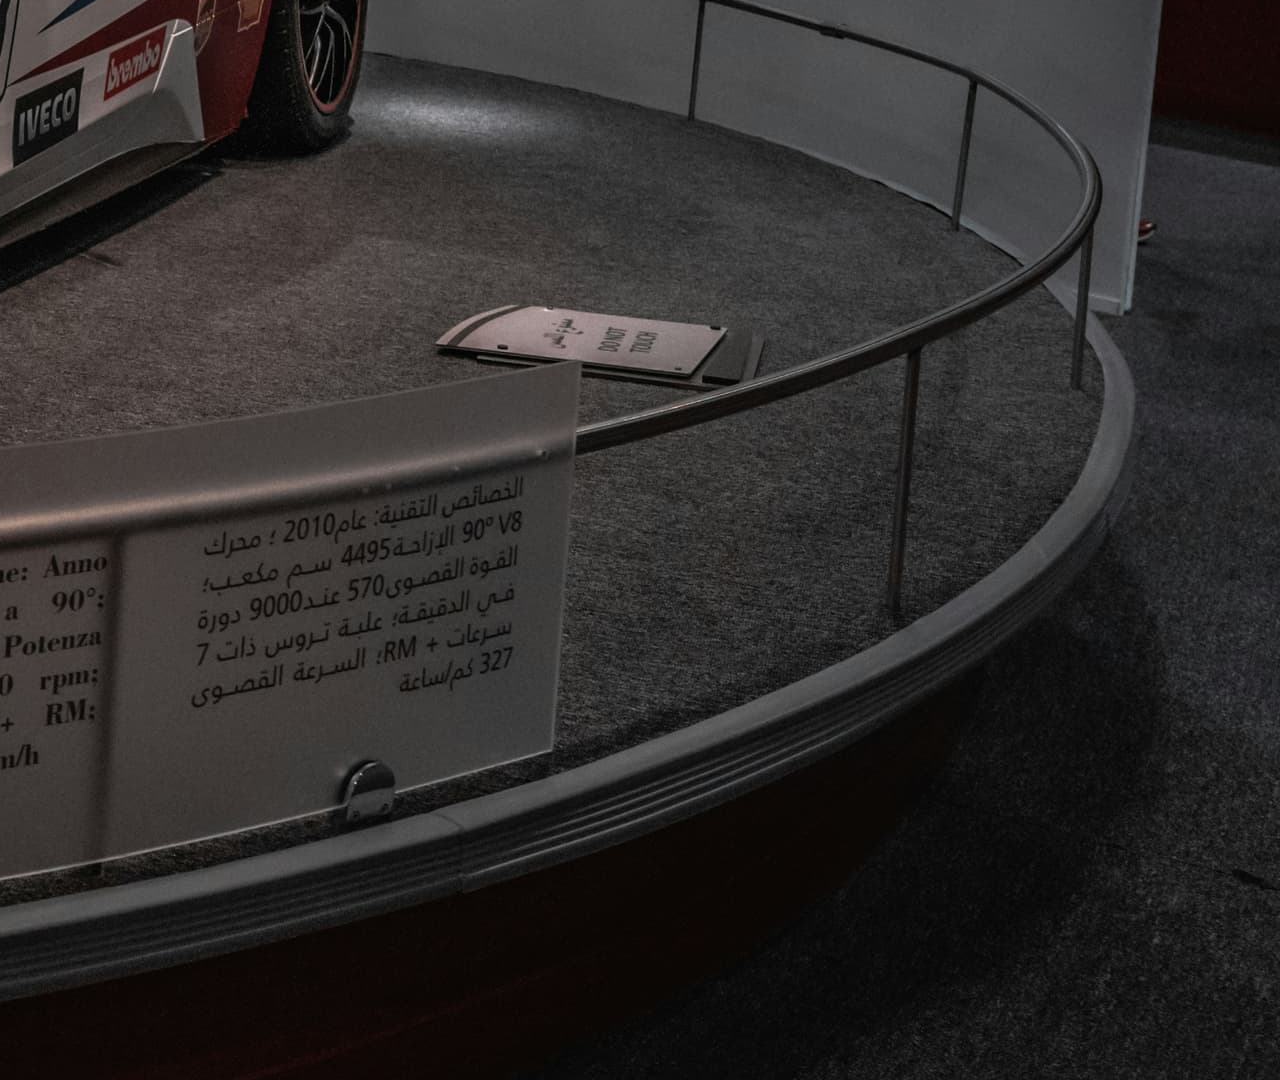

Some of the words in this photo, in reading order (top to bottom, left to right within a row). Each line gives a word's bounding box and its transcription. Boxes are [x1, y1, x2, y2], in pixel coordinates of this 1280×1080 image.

[106, 39, 161, 94] brembo
[17, 87, 77, 147] IVECO
[598, 340, 621, 353] DO
[603, 326, 628, 341] NOT
[630, 330, 658, 354] TOUCH
[374, 493, 438, 528] التقنية:
[441, 478, 524, 519] الخصائص
[498, 510, 522, 535] V8
[204, 531, 262, 559] محرك
[43, 555, 108, 580] Anno
[286, 558, 333, 587] سم
[469, 545, 518, 579] القوة
[202, 562, 279, 593] مكعب؛
[4, 606, 18, 621] a
[392, 590, 470, 627] الدقيقة؛
[476, 583, 514, 618] في
[198, 610, 241, 634] دورة
[338, 611, 382, 639] علبة
[446, 622, 512, 648] سرعات
[4, 632, 102, 658] Potenza
[197, 642, 210, 666] 7
[216, 636, 256, 662] ذات
[264, 622, 331, 659] تروس
[426, 637, 439, 652] +
[292, 647, 366, 684] السرعة
[480, 646, 514, 674] 327
[40, 669, 98, 695] rpm;
[191, 664, 284, 708] القصوى
[0, 718, 14, 732] +
[46, 698, 95, 726] RM;
